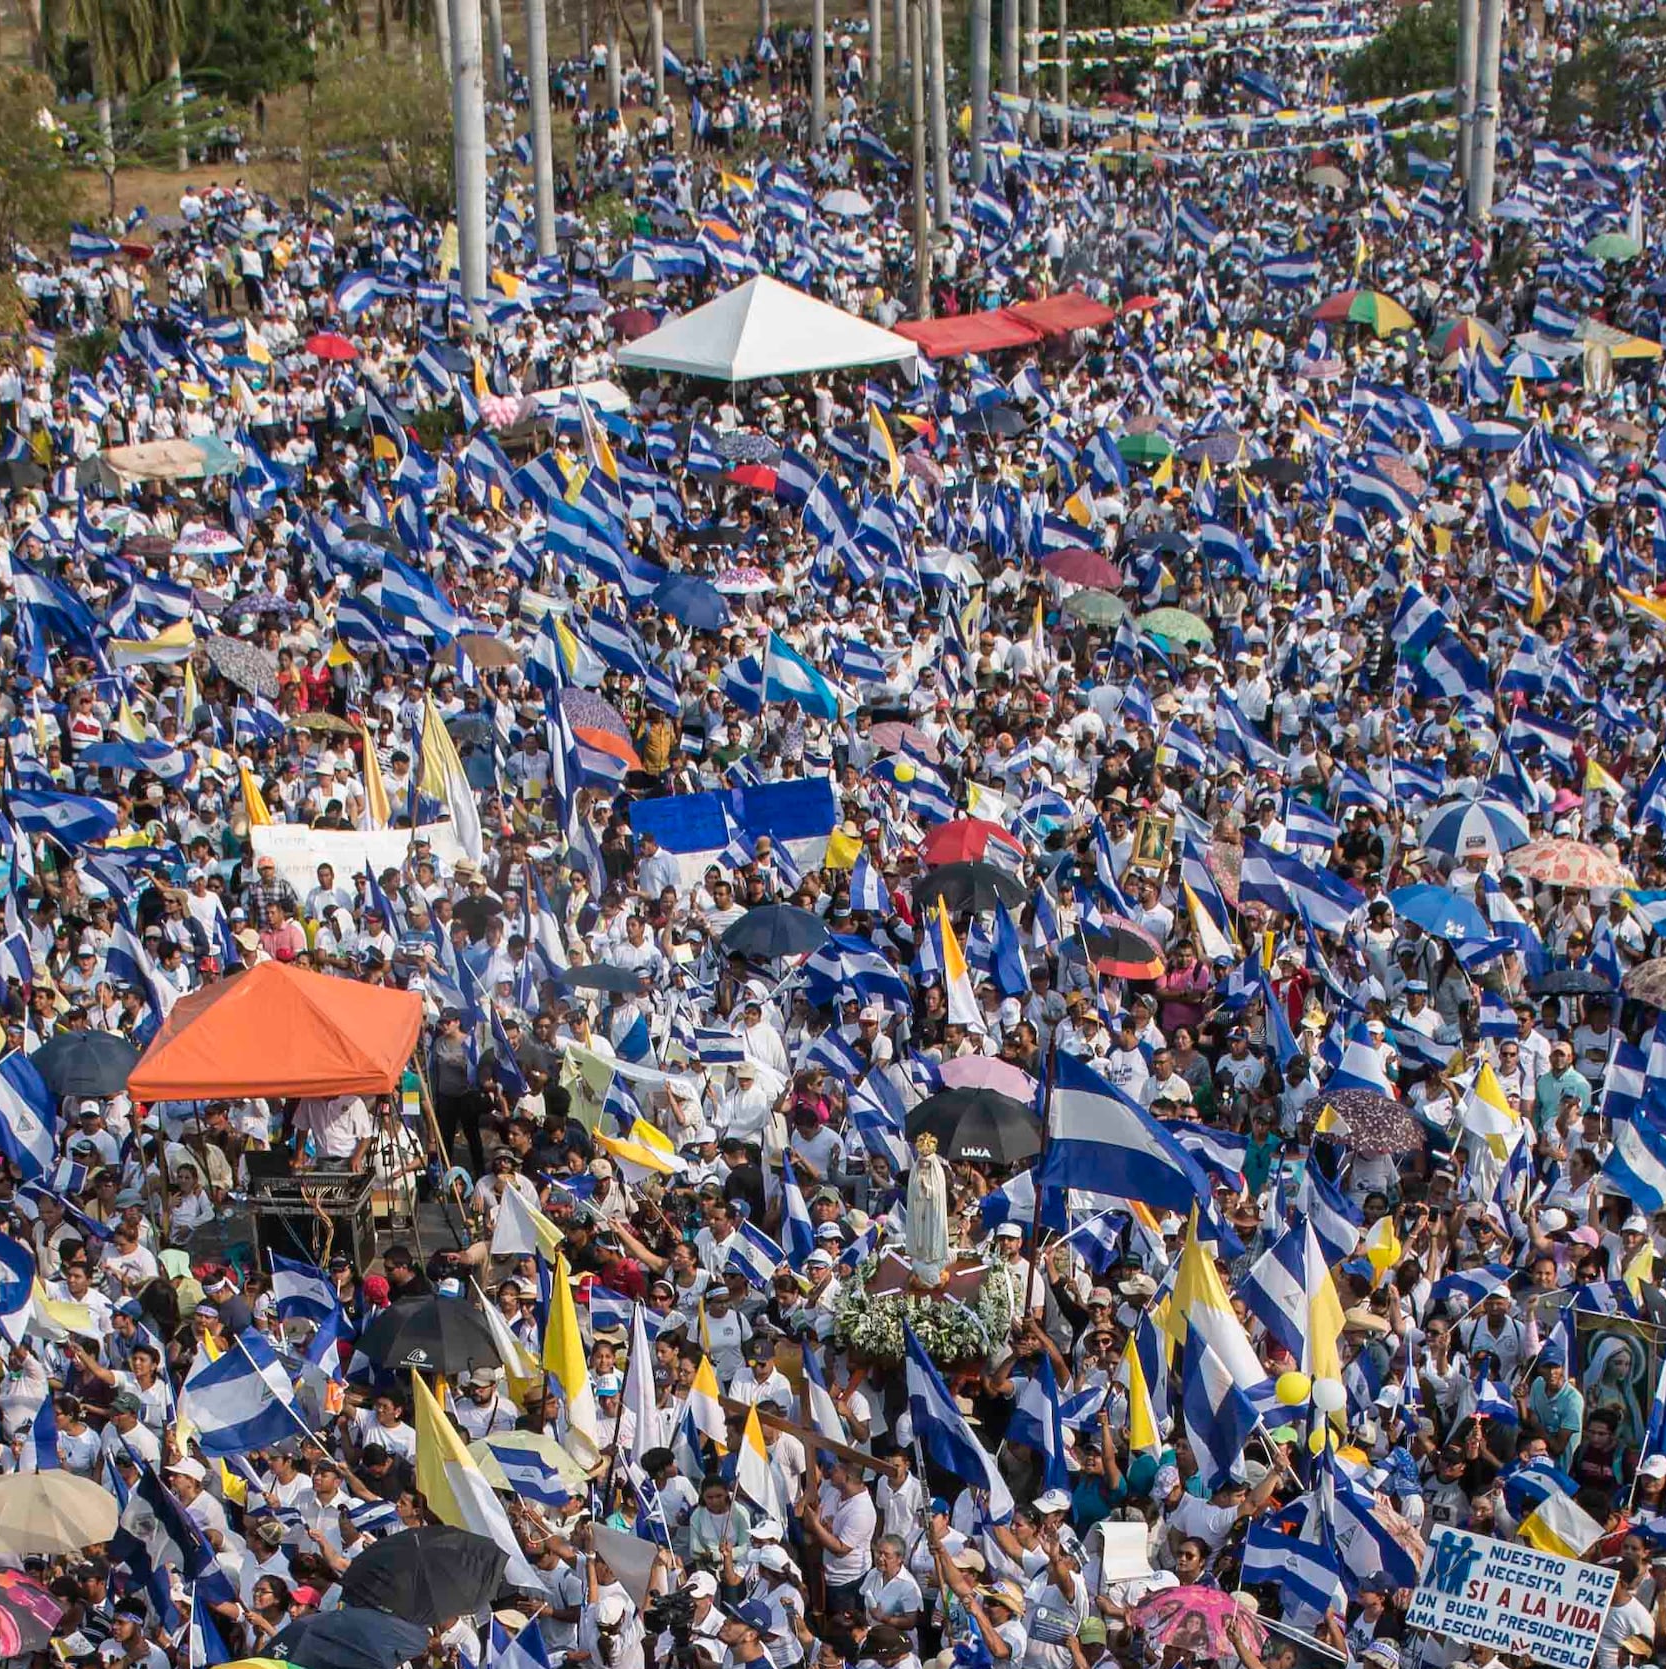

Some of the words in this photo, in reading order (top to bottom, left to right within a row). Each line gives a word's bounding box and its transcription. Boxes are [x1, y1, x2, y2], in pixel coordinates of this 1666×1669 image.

[961, 1148, 991, 1158] UMA
[1484, 1564, 1562, 1596] NECESITA
[1576, 1589, 1608, 1608] PAZ
[1490, 1546, 1566, 1576] NUESTRO
[1578, 1569, 1616, 1589] PAIS
[1415, 1592, 1437, 1609] UN
[1445, 1601, 1487, 1621] BUEN
[1498, 1613, 1596, 1651] PRESIDENTE
[1467, 1580, 1489, 1602] SI
[1498, 1592, 1511, 1608] A
[1522, 1594, 1546, 1617] LA
[1556, 1602, 1601, 1632] VIDA
[1511, 1636, 1530, 1653] AL
[1530, 1641, 1590, 1669] PUEBLO
